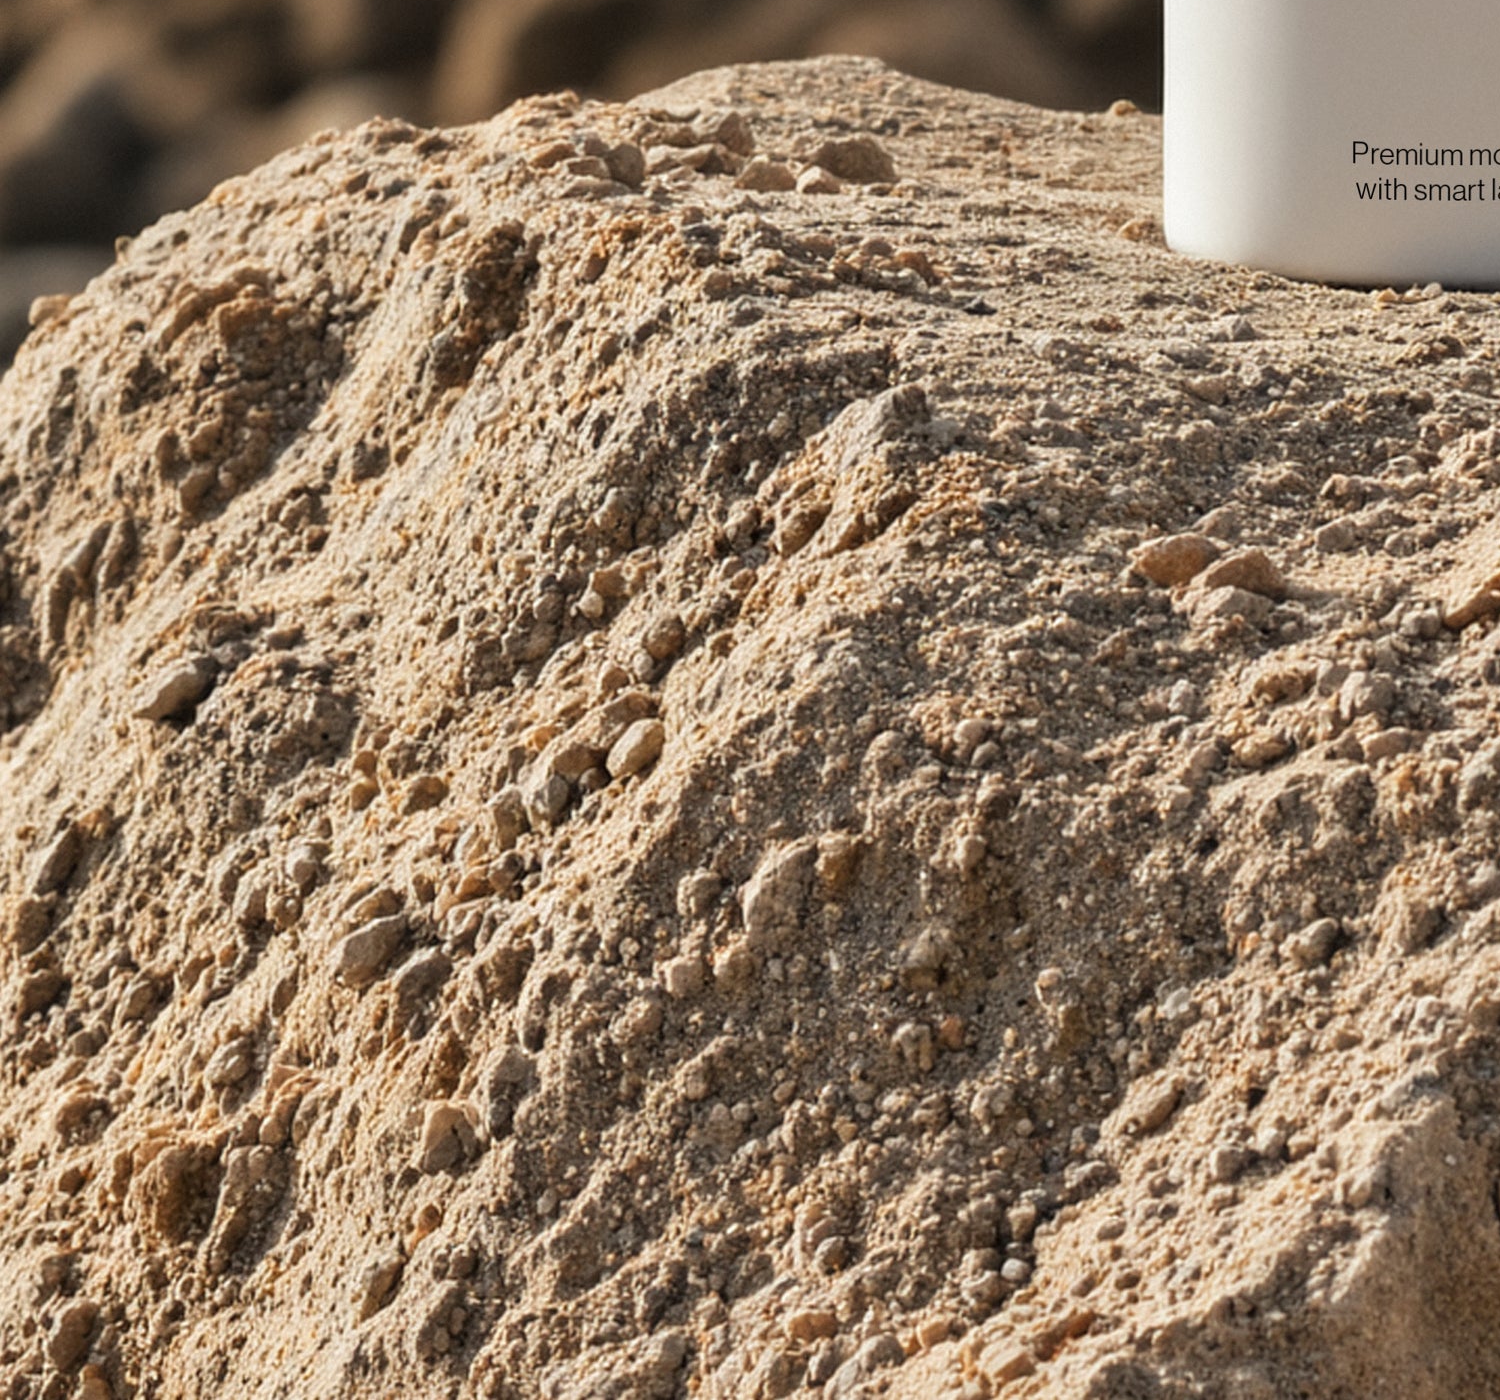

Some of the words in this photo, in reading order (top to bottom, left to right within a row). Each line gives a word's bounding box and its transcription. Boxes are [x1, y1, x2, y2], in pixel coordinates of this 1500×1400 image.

[1352, 140, 1464, 167] Premium
[1355, 176, 1408, 201] with
[1413, 179, 1486, 202] smart
